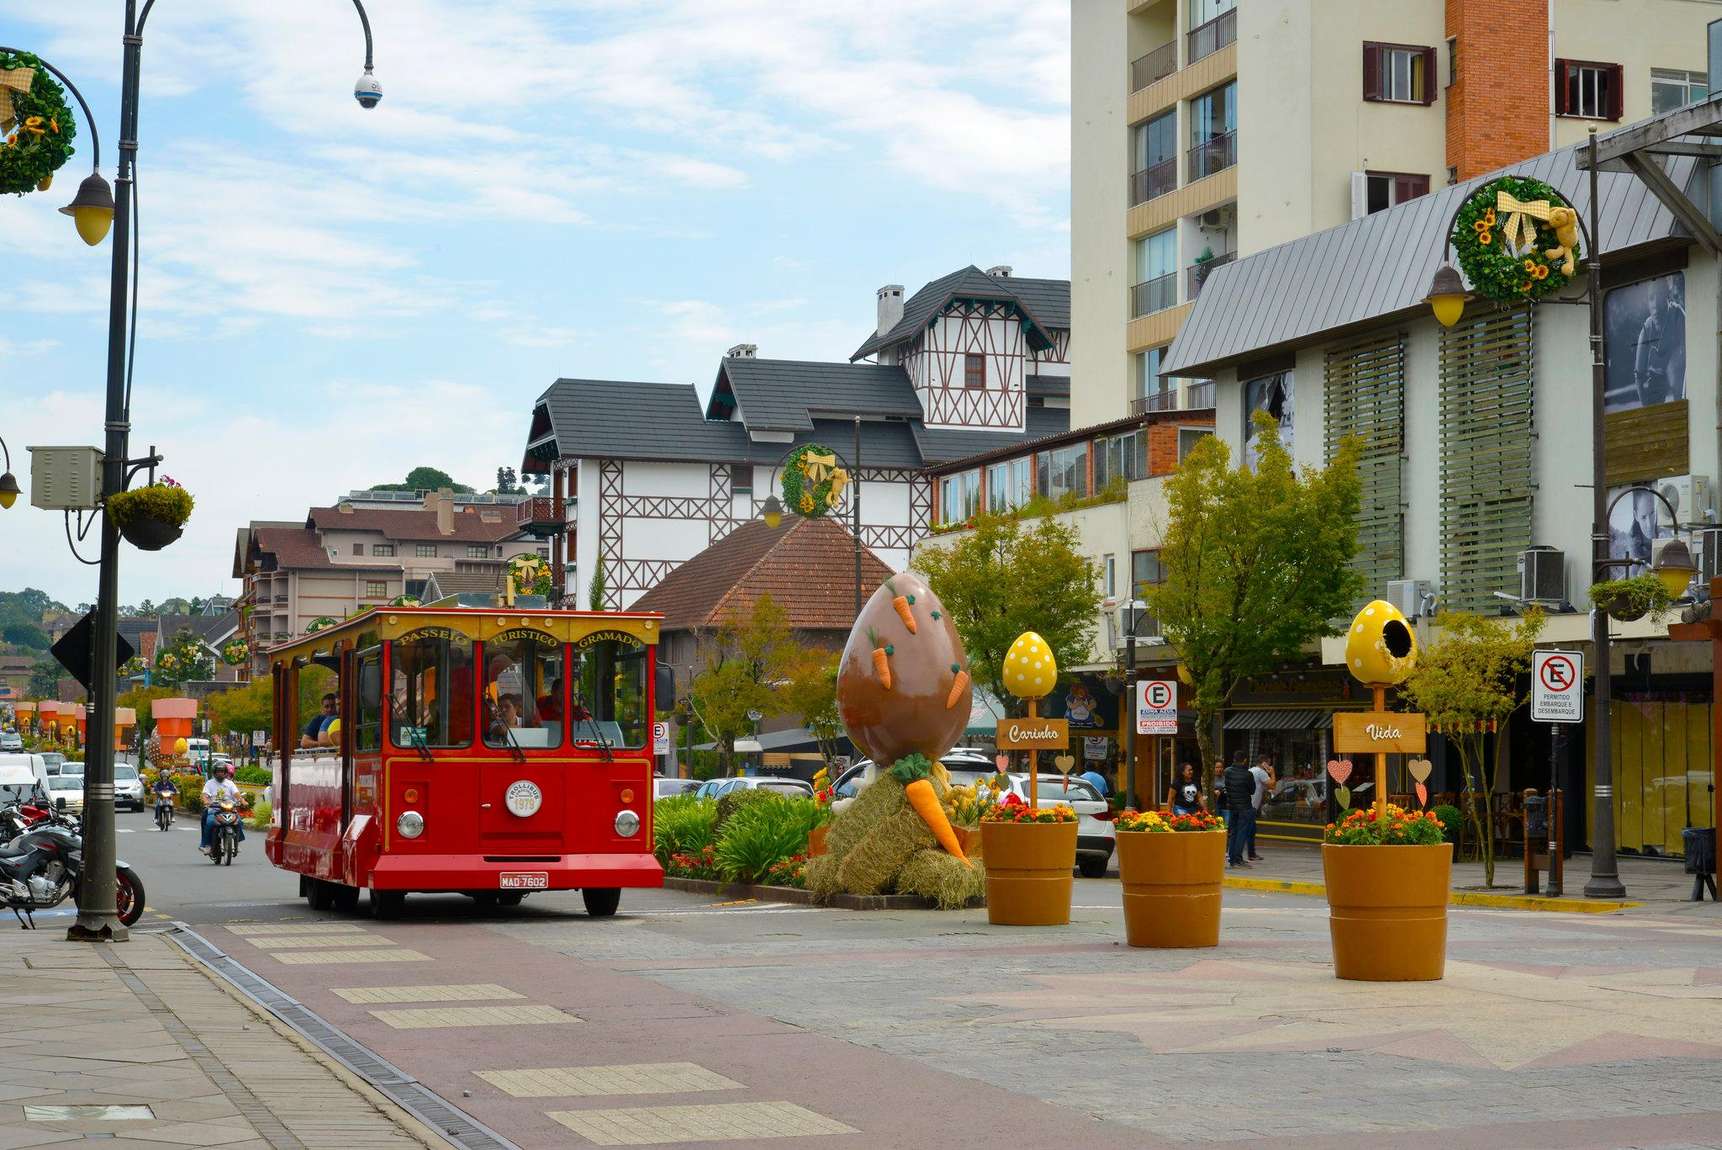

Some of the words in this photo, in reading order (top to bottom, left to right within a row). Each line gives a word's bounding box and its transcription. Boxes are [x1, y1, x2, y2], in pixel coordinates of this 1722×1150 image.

[400, 630, 467, 647] PASSEIO
[579, 632, 641, 649] GRAMADO
[1153, 687, 1164, 704] E
[655, 726, 661, 736] E
[1009, 724, 1059, 743] Carinho
[1365, 724, 1402, 741] Vida
